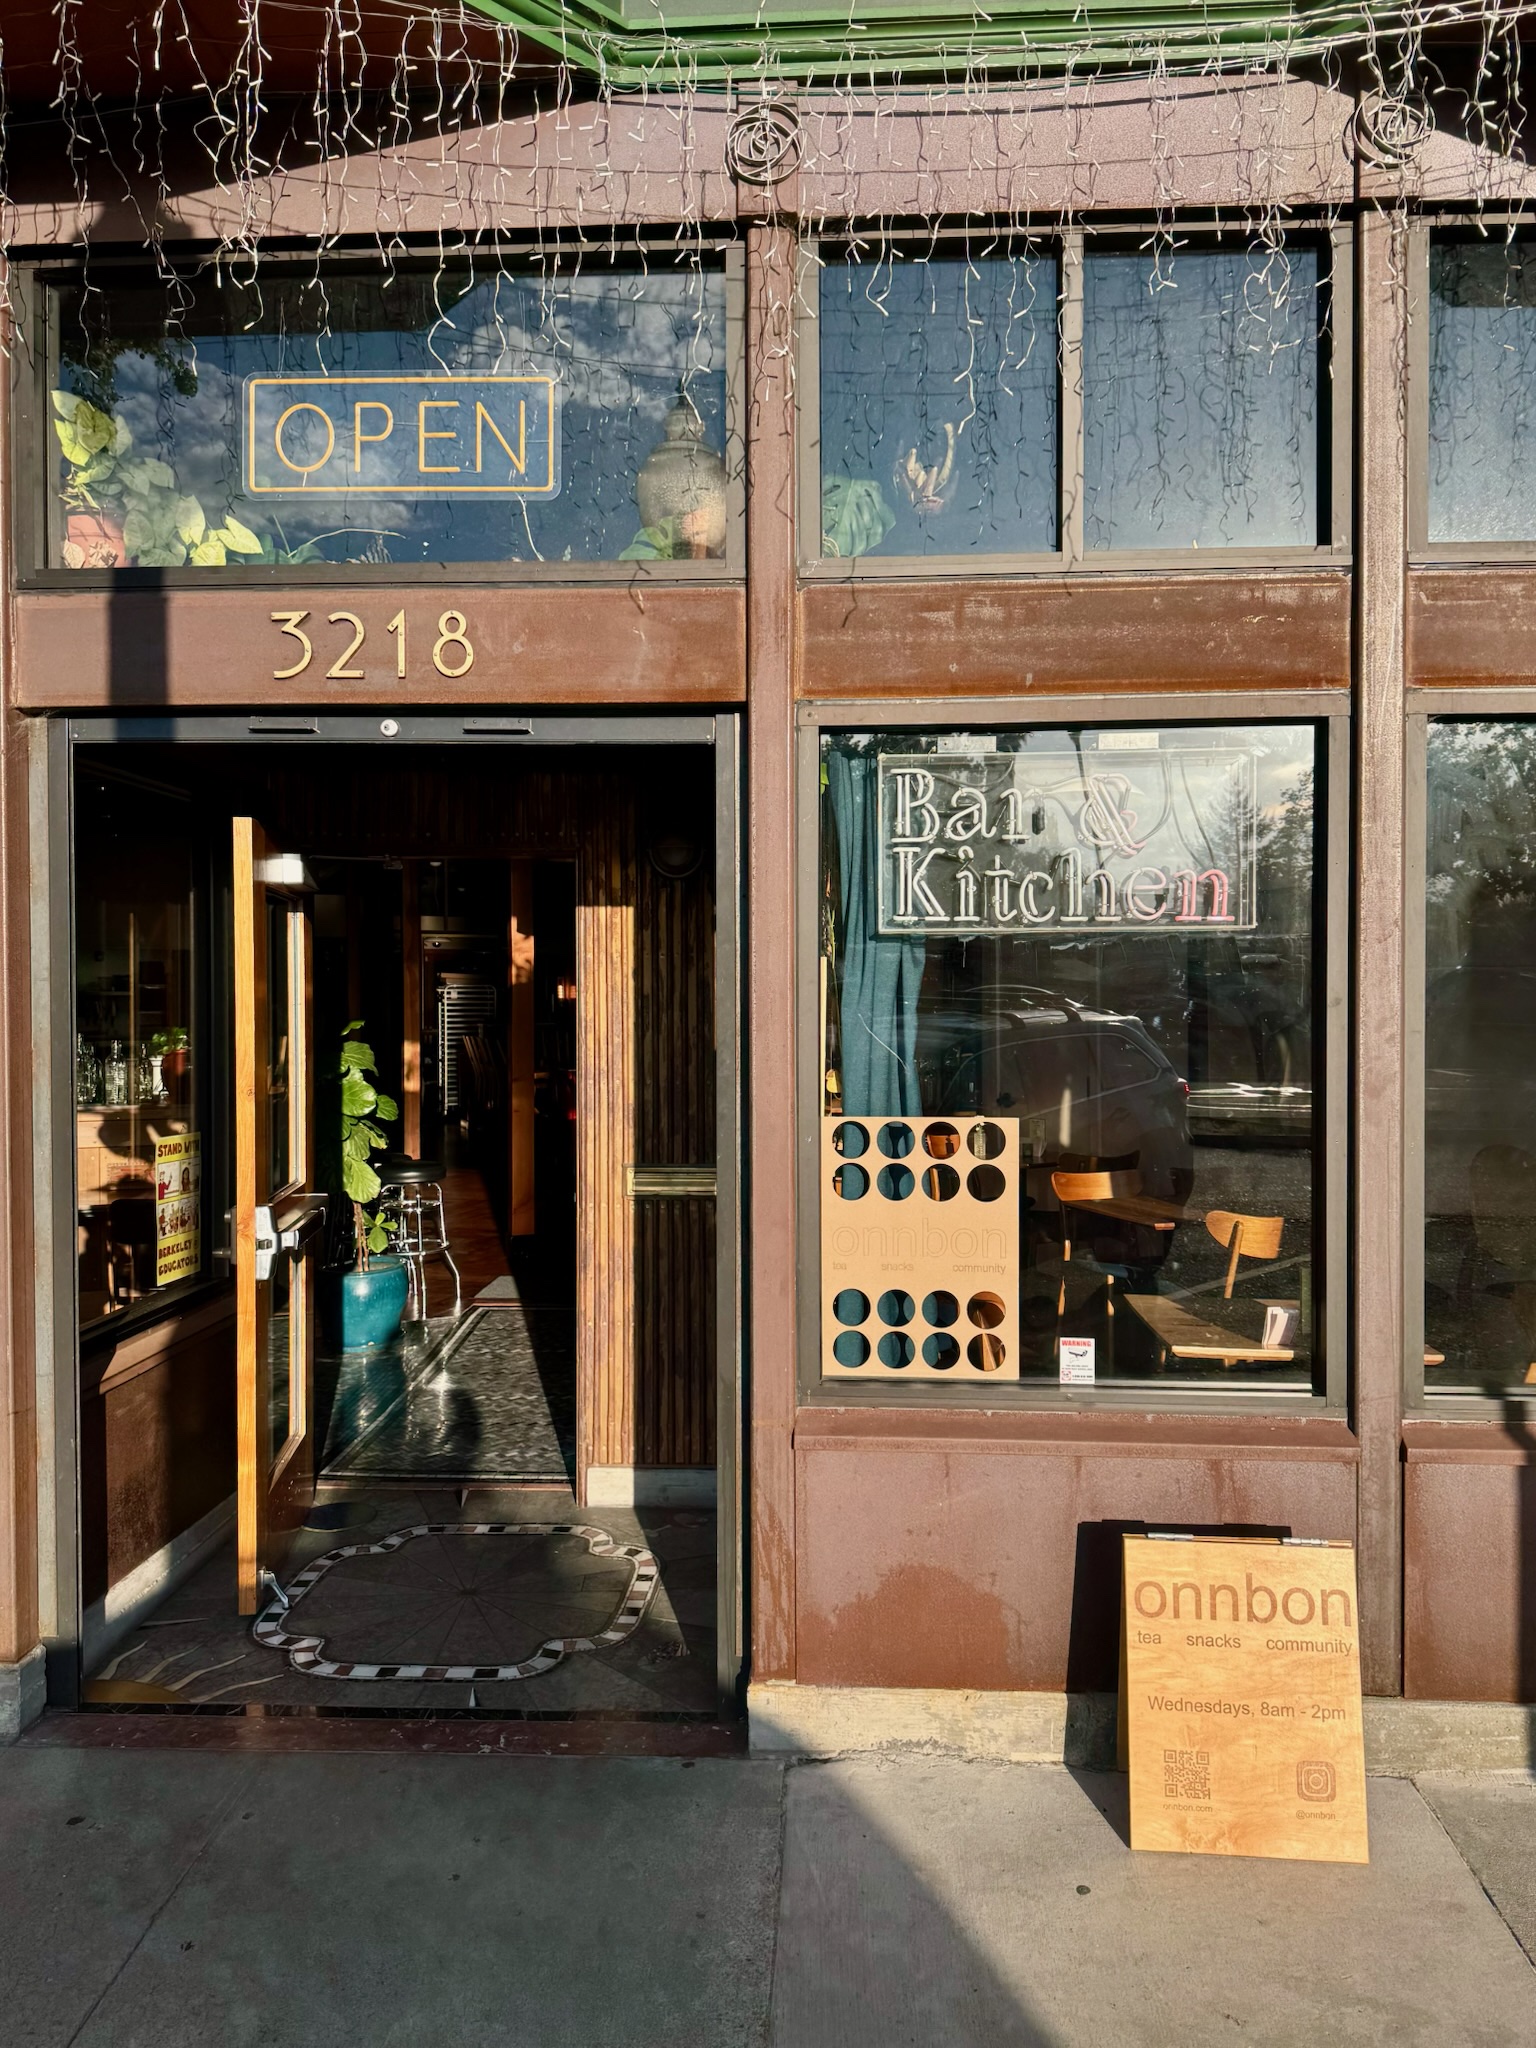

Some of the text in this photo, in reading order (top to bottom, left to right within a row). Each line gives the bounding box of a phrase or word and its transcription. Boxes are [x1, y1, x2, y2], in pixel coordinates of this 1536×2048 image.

[275, 400, 526, 474] OPEN
[270, 609, 474, 679] 3218
[890, 768, 1148, 857] Bar &
[892, 846, 1235, 922] Kitchen
[157, 1142, 183, 1158] STAND
[158, 1239, 192, 1260] BERKELEY
[832, 1217, 1007, 1260] onnbon
[158, 1253, 199, 1277] EDUCATORS
[832, 1261, 1007, 1275] tea snacks community
[1134, 1572, 1352, 1627] onnbon
[1137, 1630, 1353, 1657] tea snacks community
[1147, 1695, 1255, 1718] Wednesdays,
[1260, 1701, 1295, 1718] 8am
[1311, 1704, 1346, 1723] 2pm
[1162, 1803, 1214, 1813] onnbon.com
